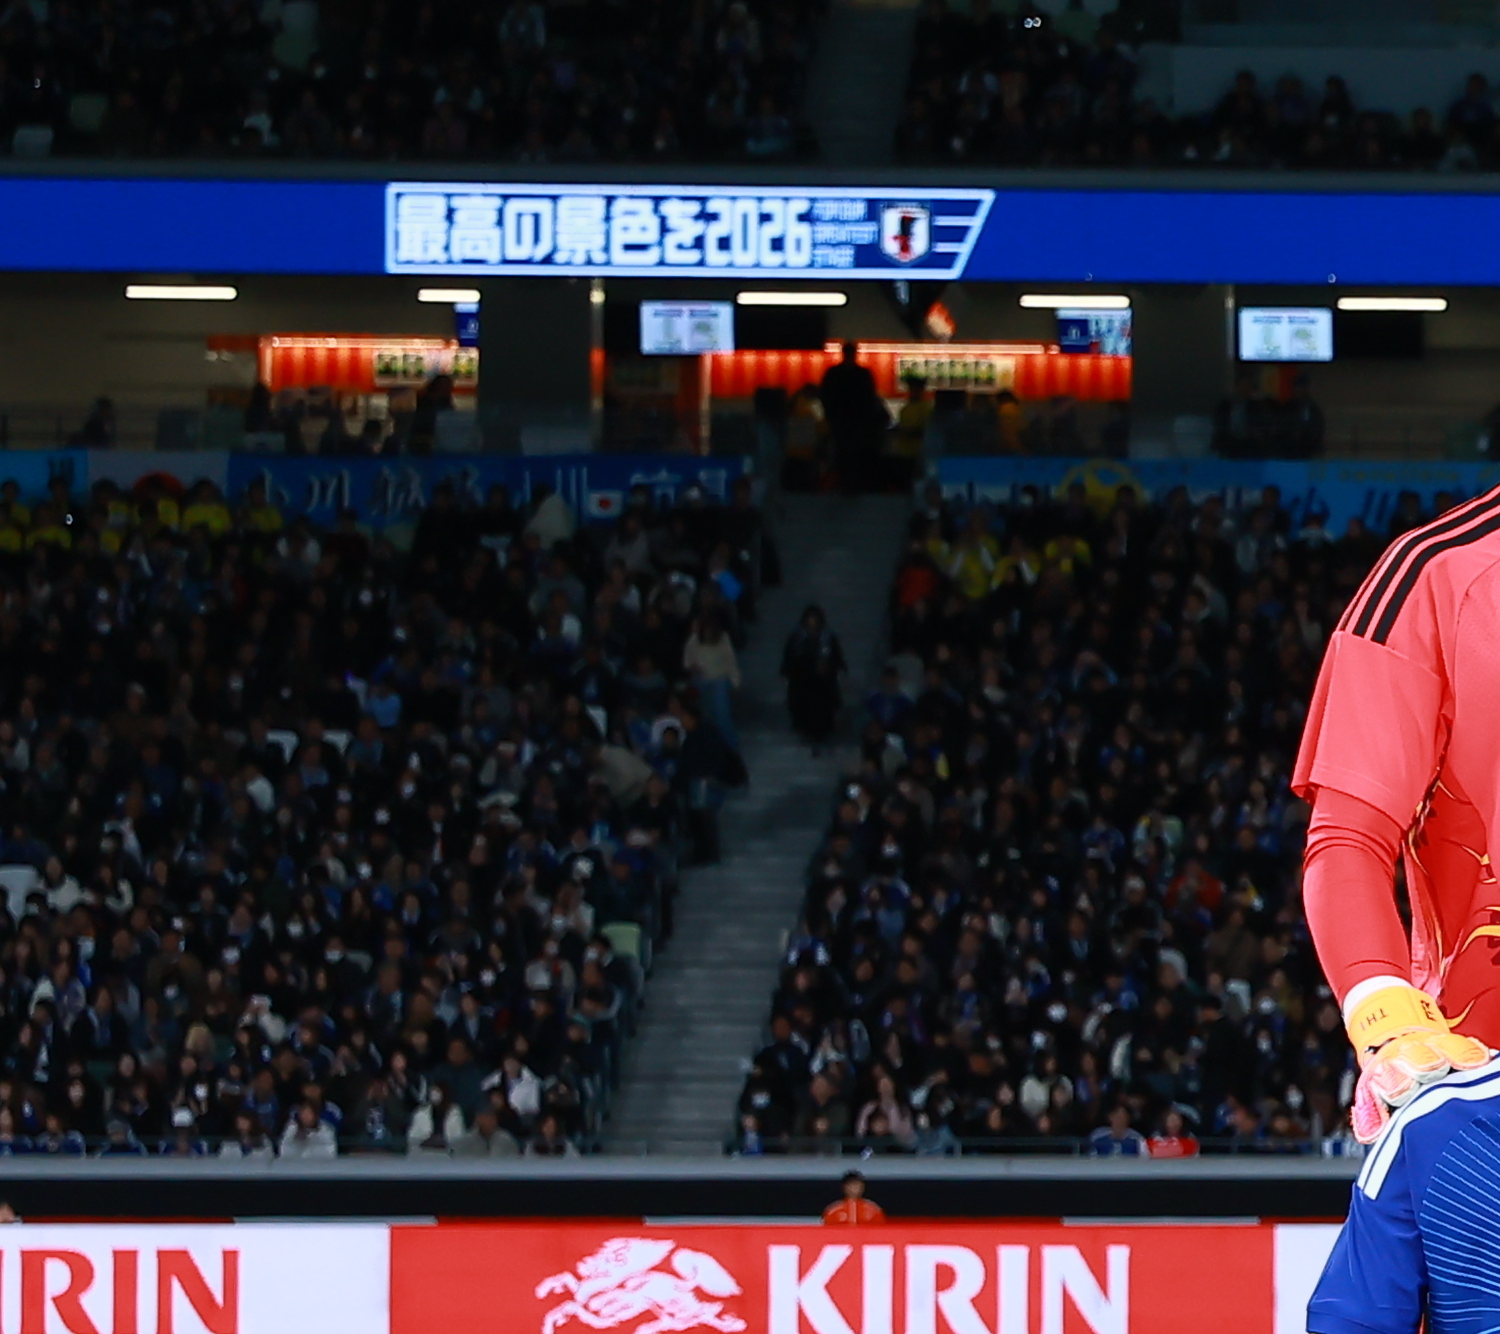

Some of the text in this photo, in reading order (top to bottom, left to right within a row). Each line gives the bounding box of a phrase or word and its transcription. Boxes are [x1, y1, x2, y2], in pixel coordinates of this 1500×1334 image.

[398, 194, 811, 268] 最高の景色を2026
